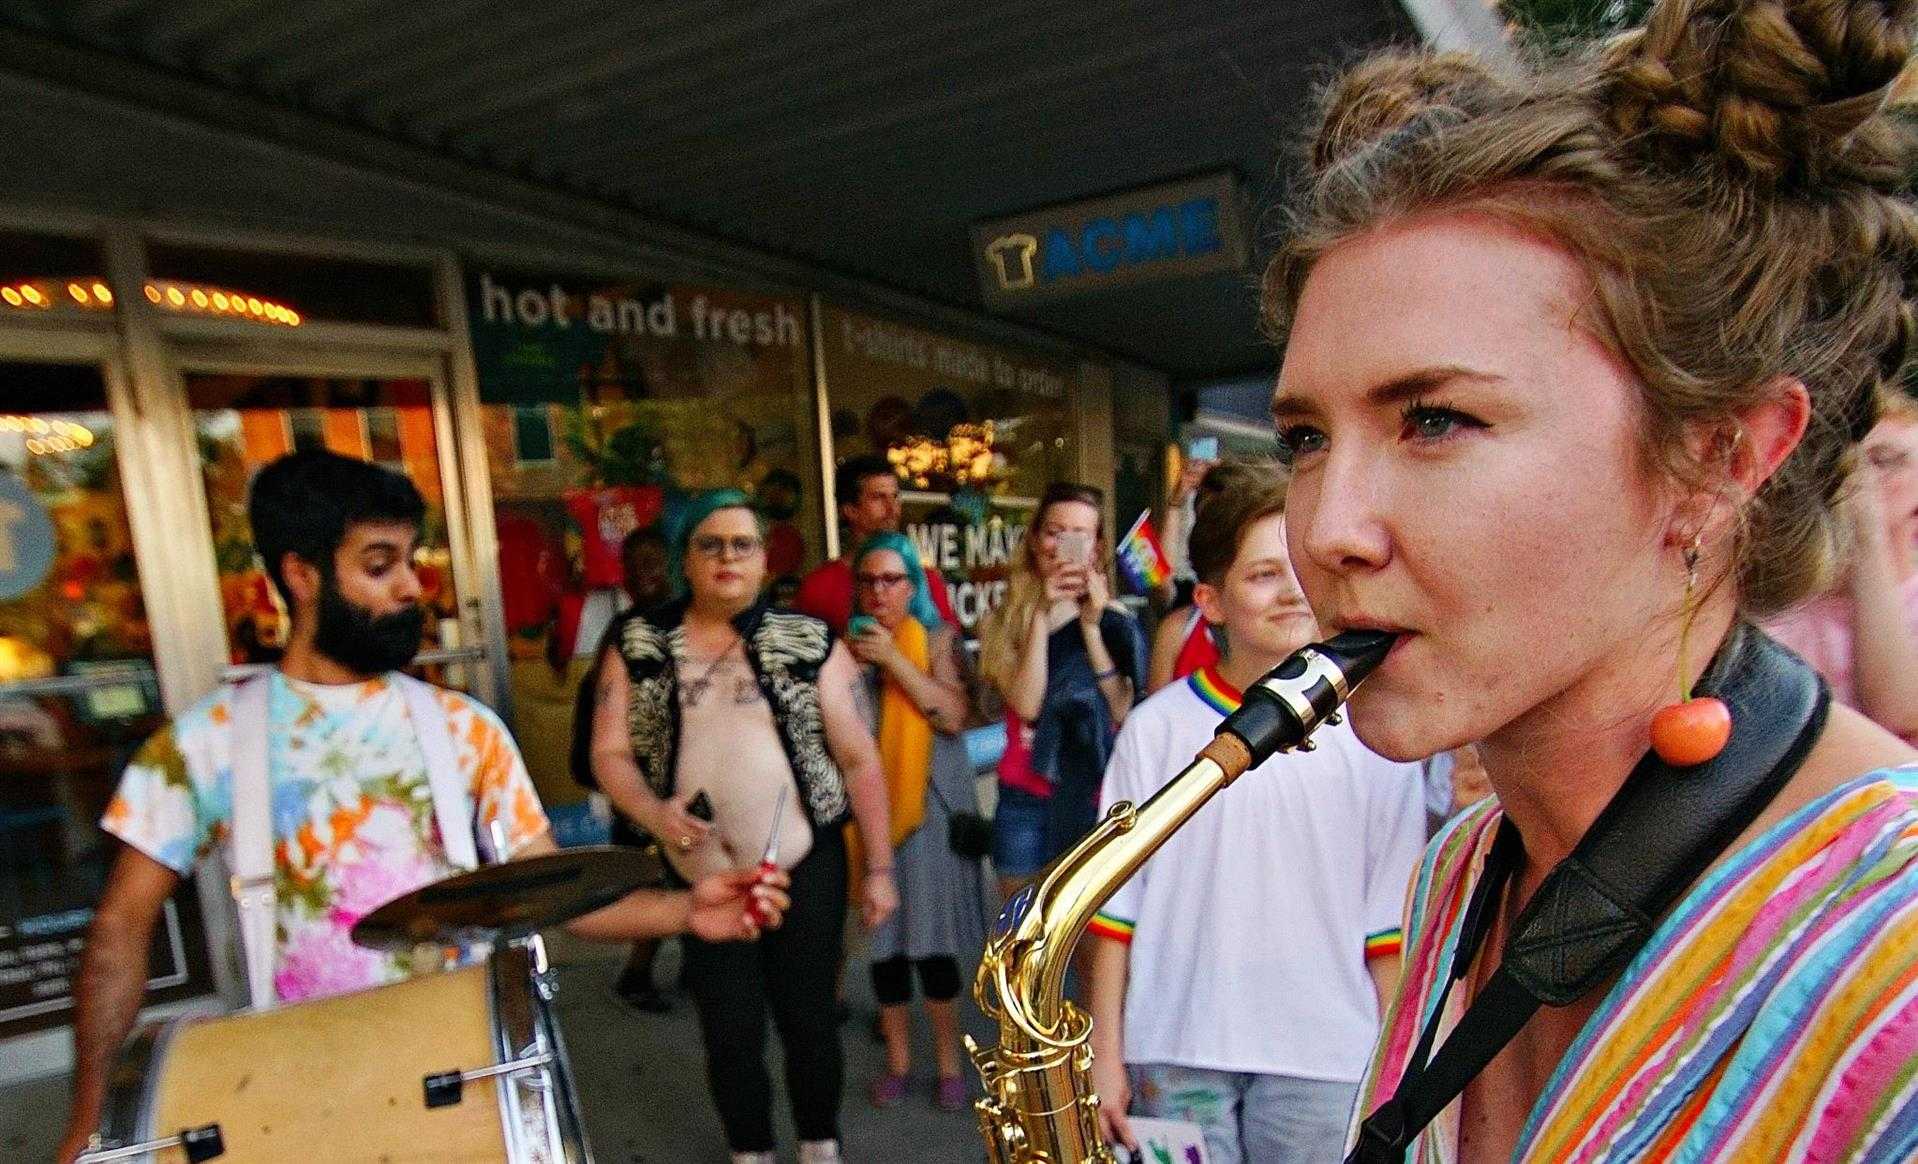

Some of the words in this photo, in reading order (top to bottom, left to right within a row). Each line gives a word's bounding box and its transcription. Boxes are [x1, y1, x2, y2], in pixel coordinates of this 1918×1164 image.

[1042, 198, 1223, 281] ACME
[480, 273, 571, 328] hot
[588, 294, 676, 337] and
[691, 295, 799, 346] fresh
[907, 523, 960, 569] WE
[965, 523, 1027, 568] MAK
